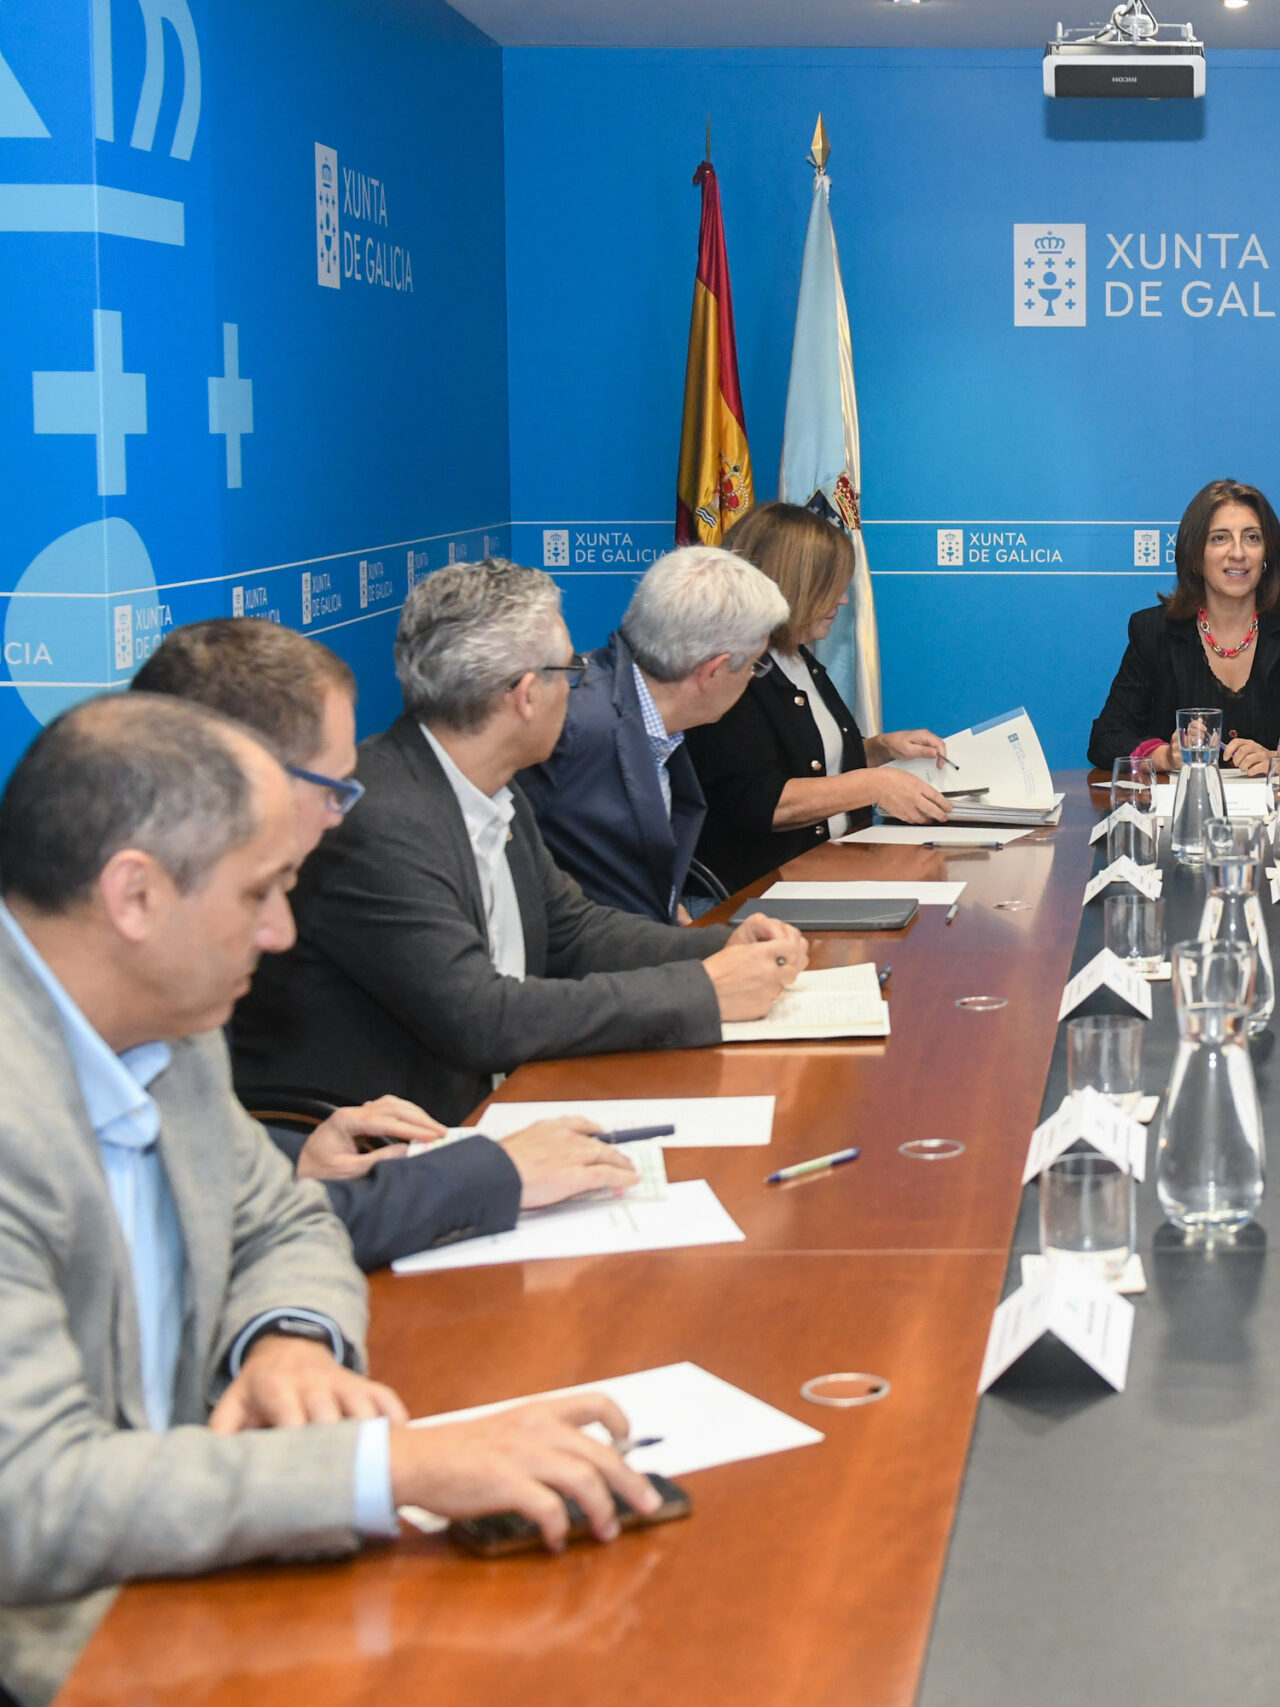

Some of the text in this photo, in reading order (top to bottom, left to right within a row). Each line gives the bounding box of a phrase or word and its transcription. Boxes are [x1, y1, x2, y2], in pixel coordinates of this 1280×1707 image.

[343, 166, 388, 228] XUNTA
[344, 230, 414, 293] DE GALICIA
[1105, 233, 1270, 270] XUNTA
[1105, 281, 1163, 318] DE
[575, 532, 633, 547] XUNTA
[969, 532, 1028, 547] XUNTA
[575, 549, 596, 563] DE
[968, 548, 1063, 563] DE GALICIA
[312, 573, 331, 594] XUNTA
[244, 587, 268, 610] XUNTA
[312, 594, 342, 617] DE GALICIA
[135, 604, 174, 631] XUNTA
[135, 636, 151, 660] DE
